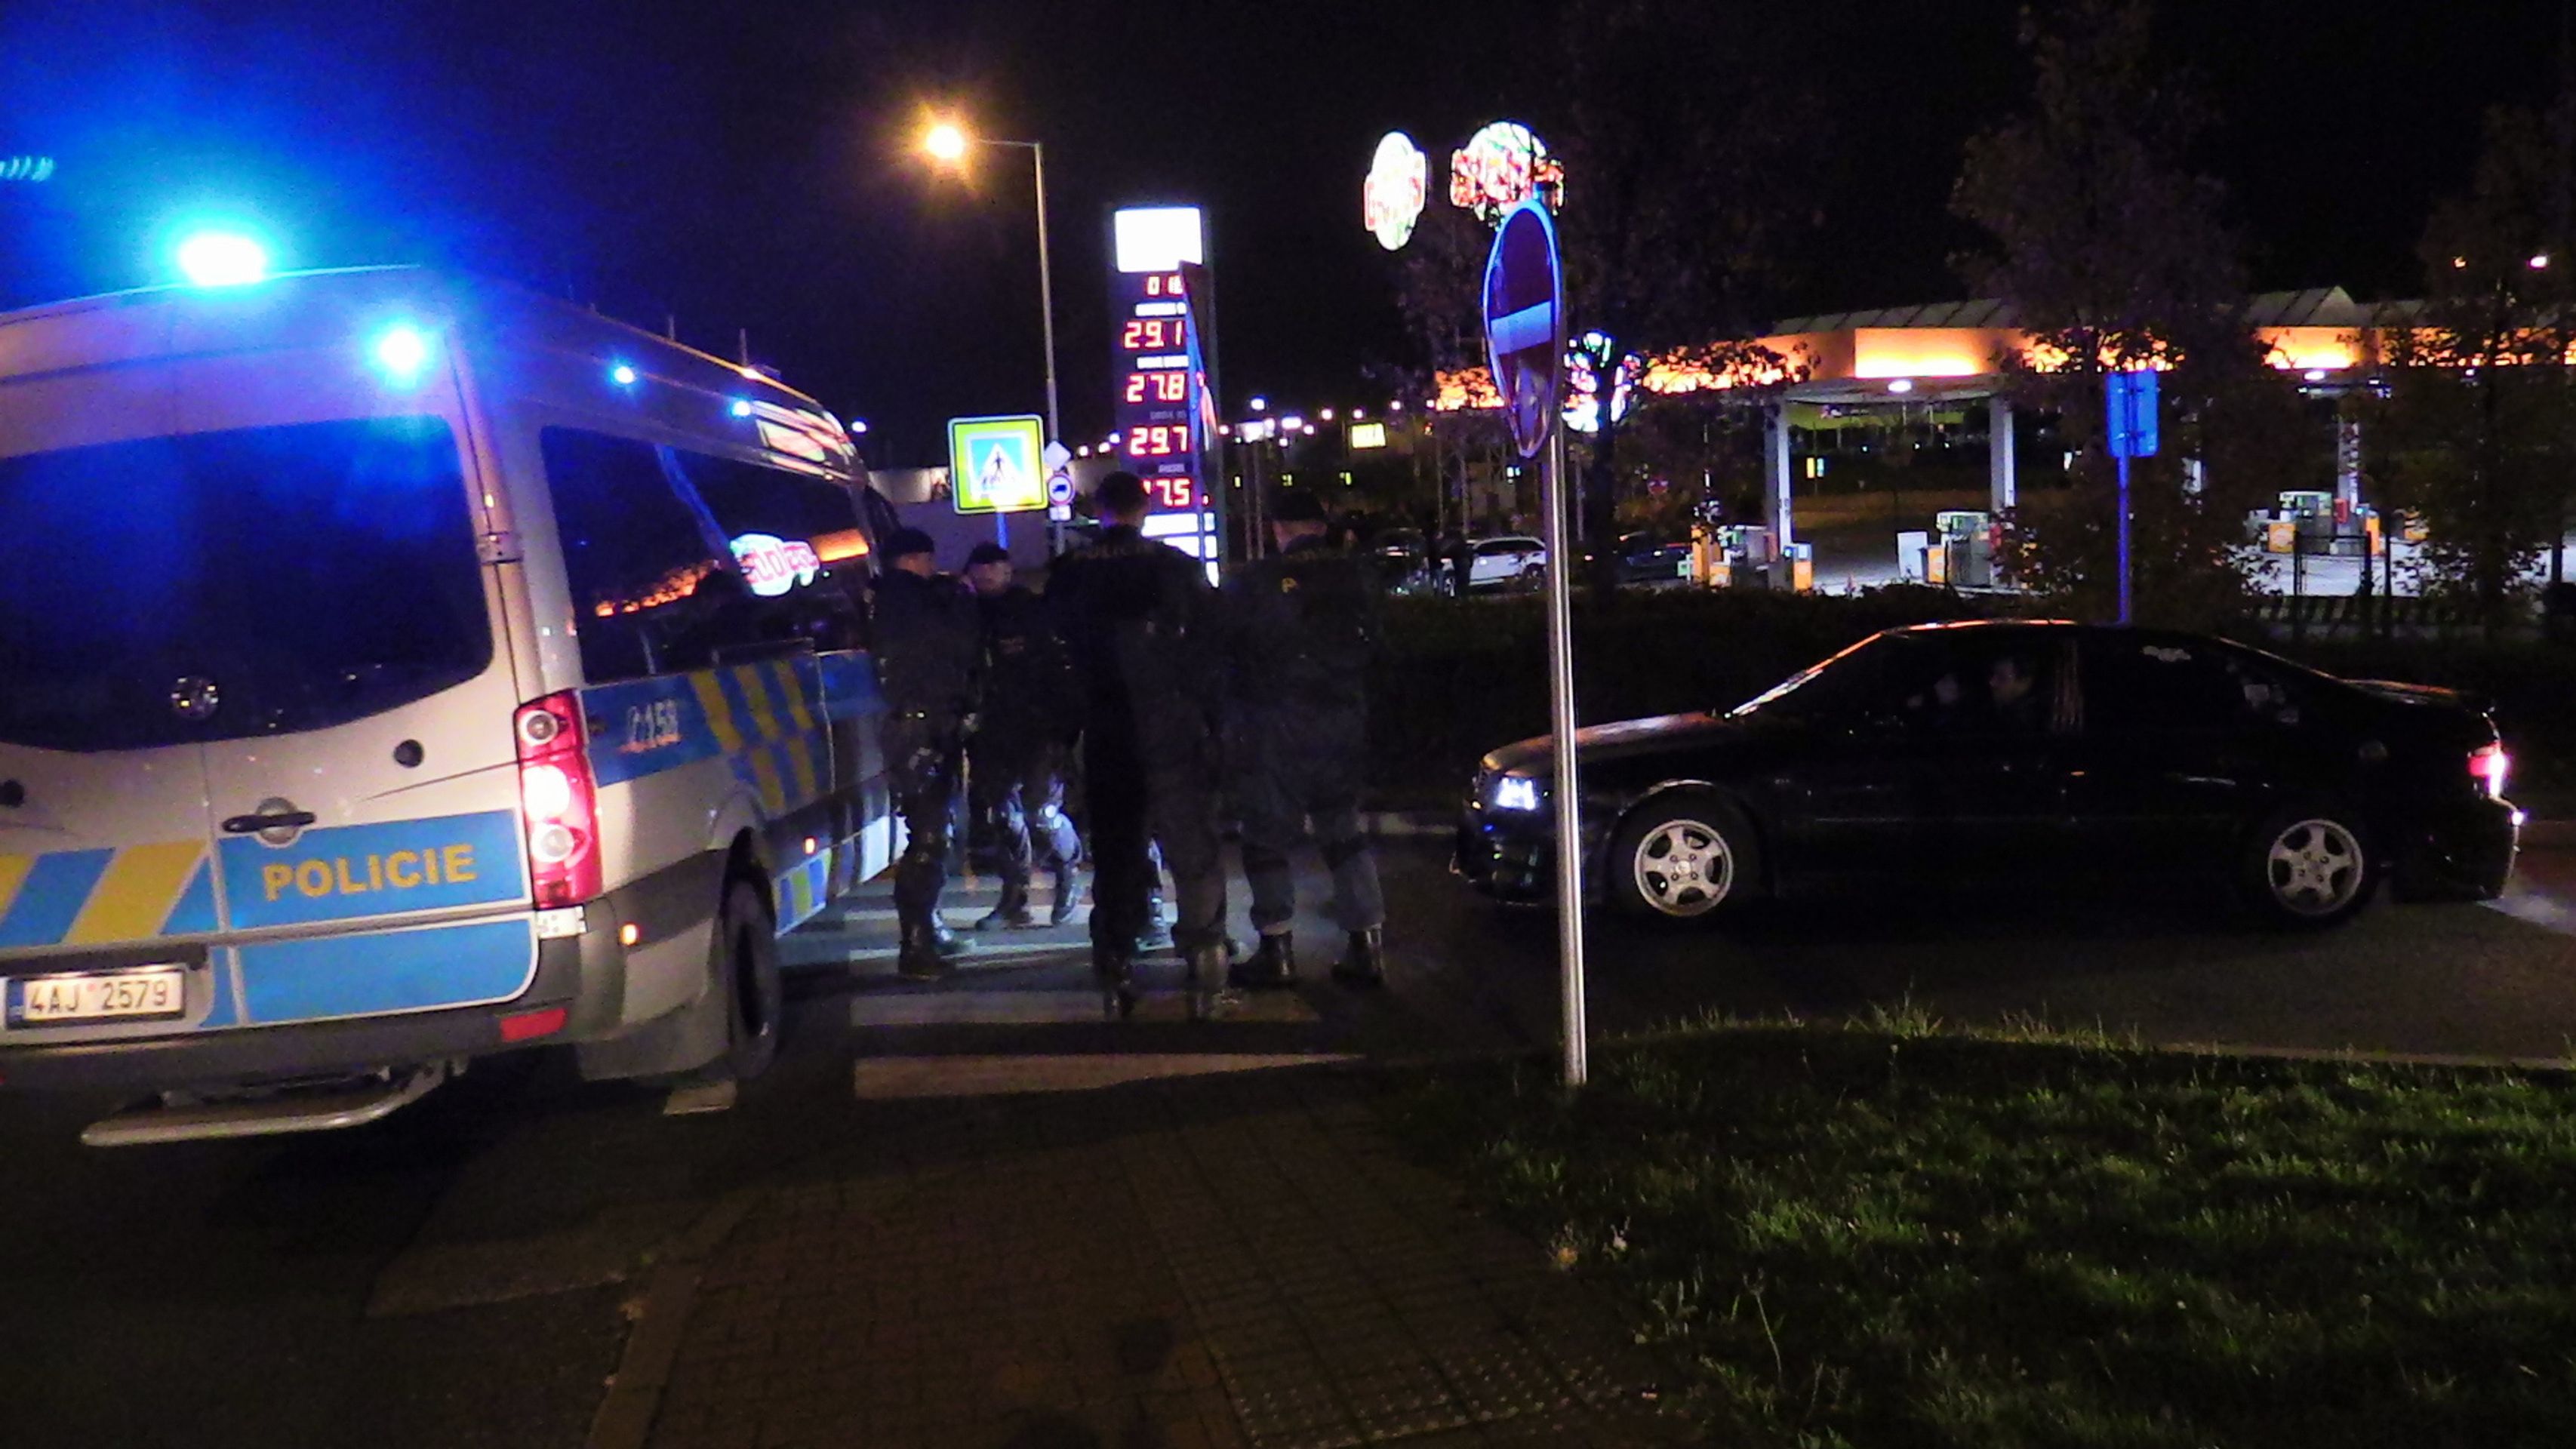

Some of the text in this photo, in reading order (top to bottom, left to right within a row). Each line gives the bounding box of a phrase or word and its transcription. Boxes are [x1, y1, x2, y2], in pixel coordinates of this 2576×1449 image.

[261, 843, 479, 903] POLICIE
[31, 979, 169, 1014] 4AJ 2579
